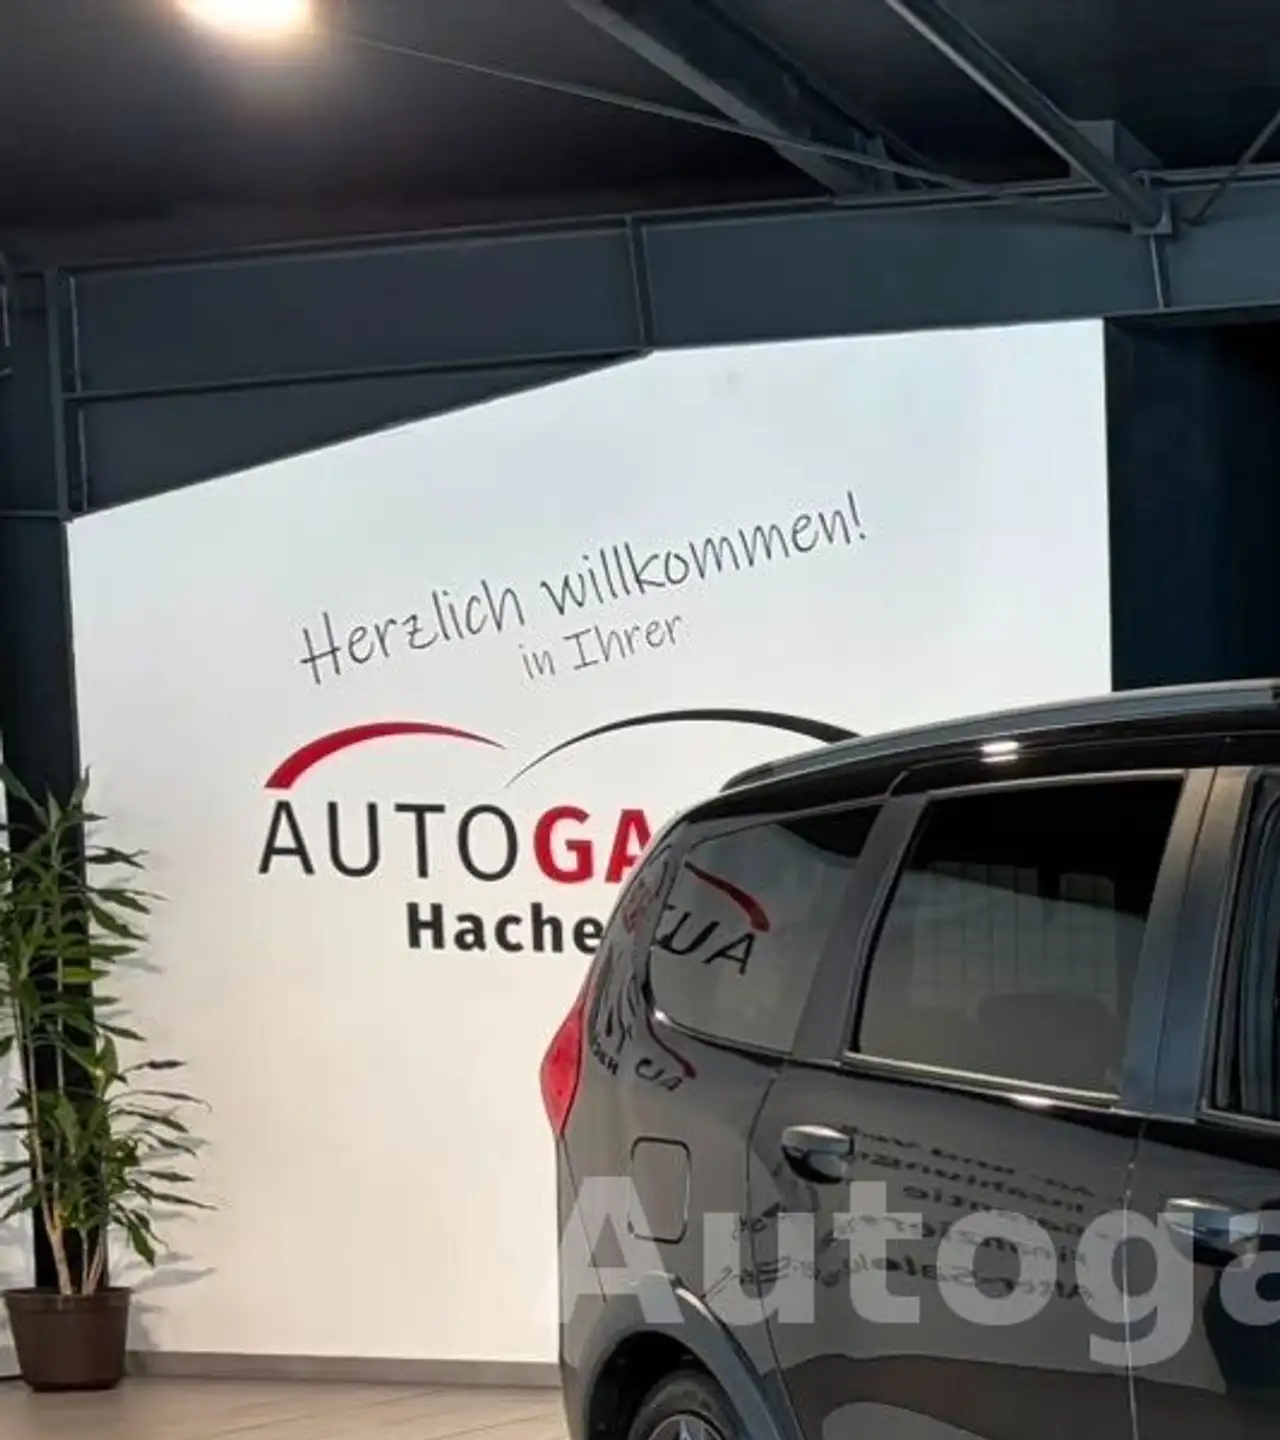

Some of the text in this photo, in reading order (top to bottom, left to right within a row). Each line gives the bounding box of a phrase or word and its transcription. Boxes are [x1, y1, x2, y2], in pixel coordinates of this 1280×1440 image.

[300, 489, 867, 685] Herzlich willkommen!
[518, 614, 683, 680] in Ihrer
[258, 799, 655, 885] AUTOGA
[406, 901, 604, 955] Hache
